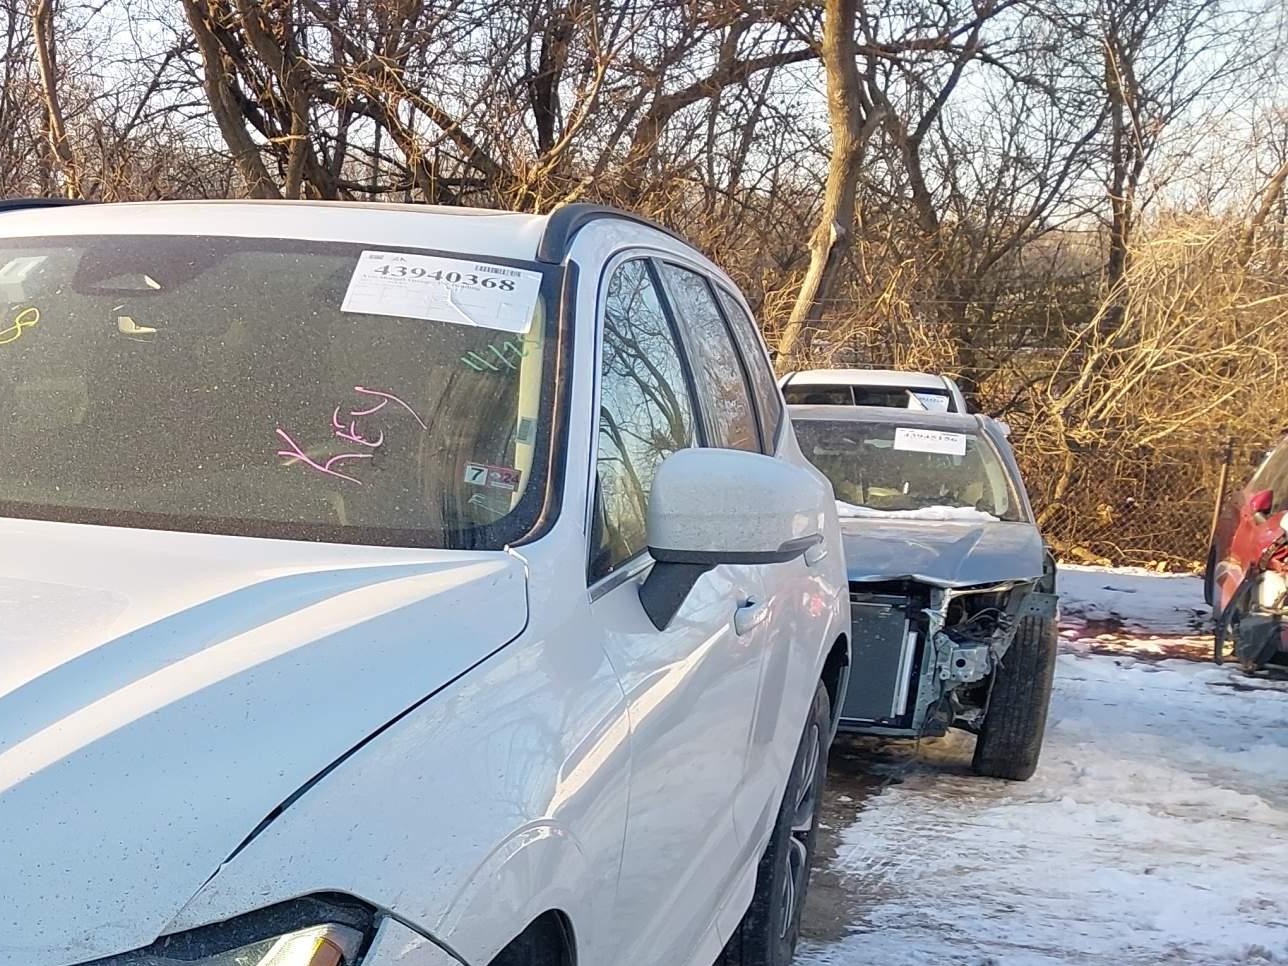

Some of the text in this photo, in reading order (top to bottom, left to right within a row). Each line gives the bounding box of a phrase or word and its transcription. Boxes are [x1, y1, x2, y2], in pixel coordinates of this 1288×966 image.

[374, 264, 516, 292] 43940368
[275, 386, 428, 486] KEY
[471, 467, 485, 481] 7
